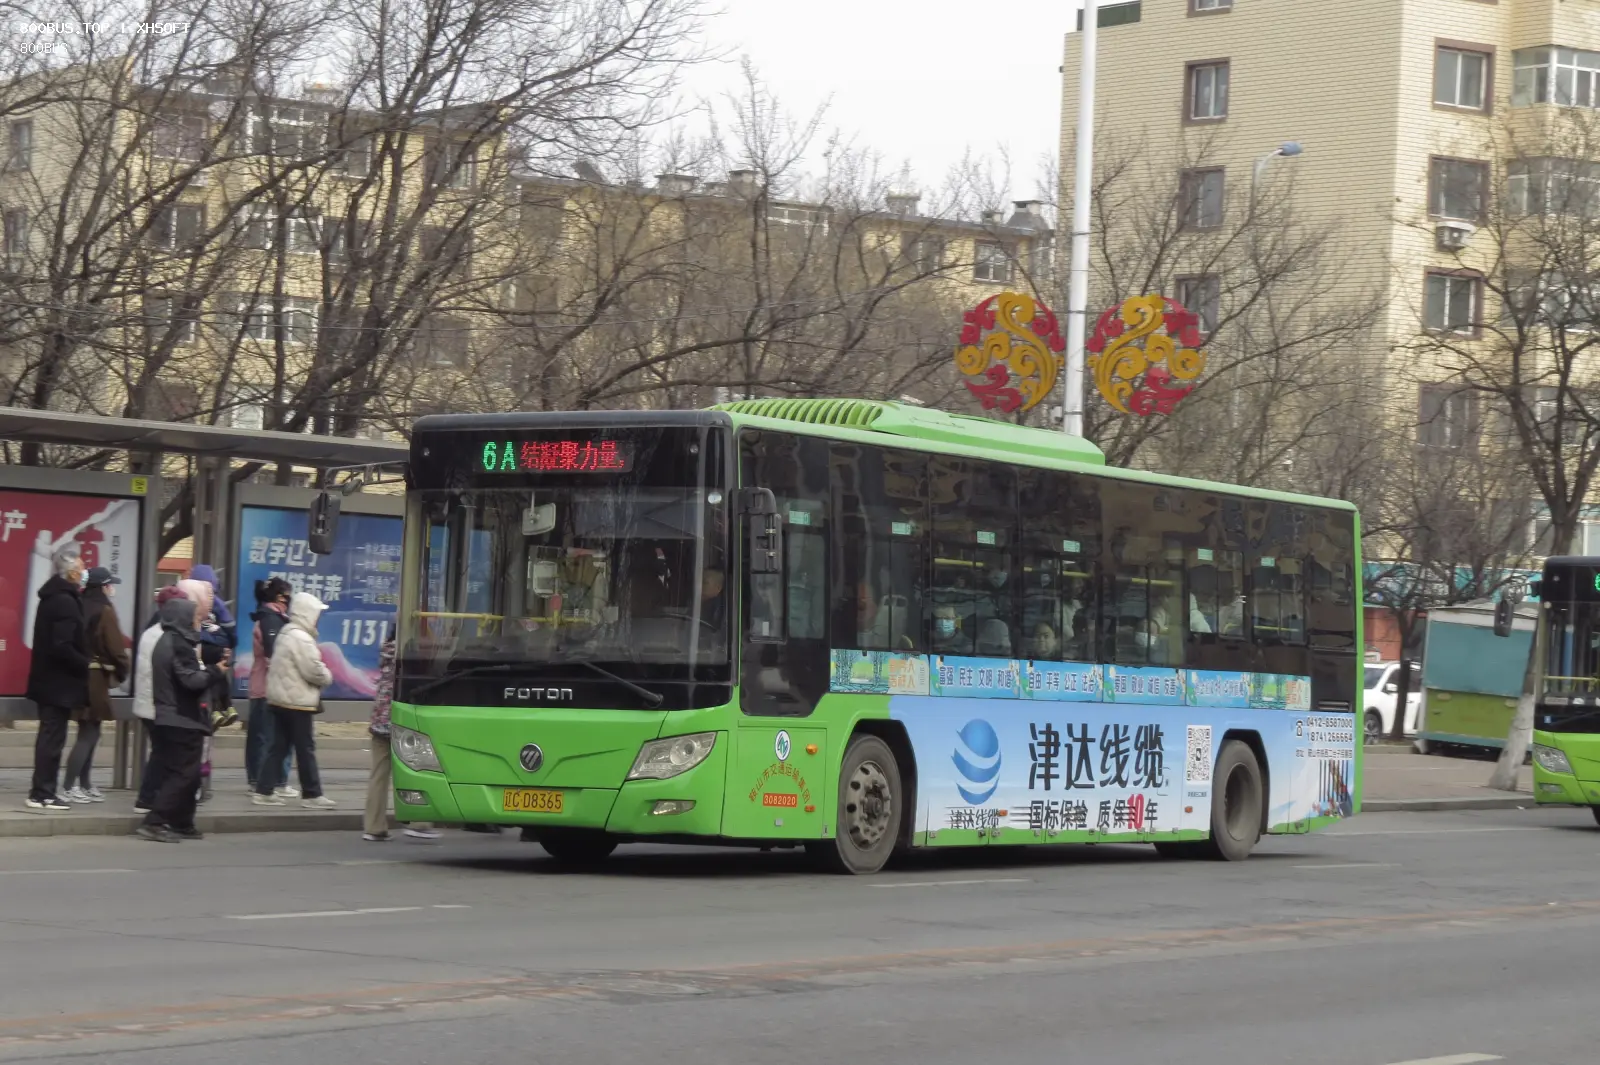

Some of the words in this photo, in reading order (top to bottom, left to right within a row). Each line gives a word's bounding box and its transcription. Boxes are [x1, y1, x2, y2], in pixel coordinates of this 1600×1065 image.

[484, 441, 516, 470] 6A
[0, 510, 28, 542] 产
[939, 666, 954, 686] 富强
[960, 667, 973, 687] 民主
[979, 668, 992, 688] 文明
[998, 669, 1012, 689] 和谐
[1029, 672, 1042, 690] 自由
[1047, 672, 1060, 691] 平等
[1065, 673, 1077, 692] 公正
[1082, 674, 1095, 693] 法治
[1115, 675, 1127, 693] 爱国
[1132, 676, 1144, 694] 敬业
[1148, 677, 1159, 695] 诚信
[1164, 678, 1176, 696] 友善
[504, 687, 573, 700] FOTON
[1028, 723, 1164, 790] 津达线缆
[763, 794, 796, 806] 3082020
